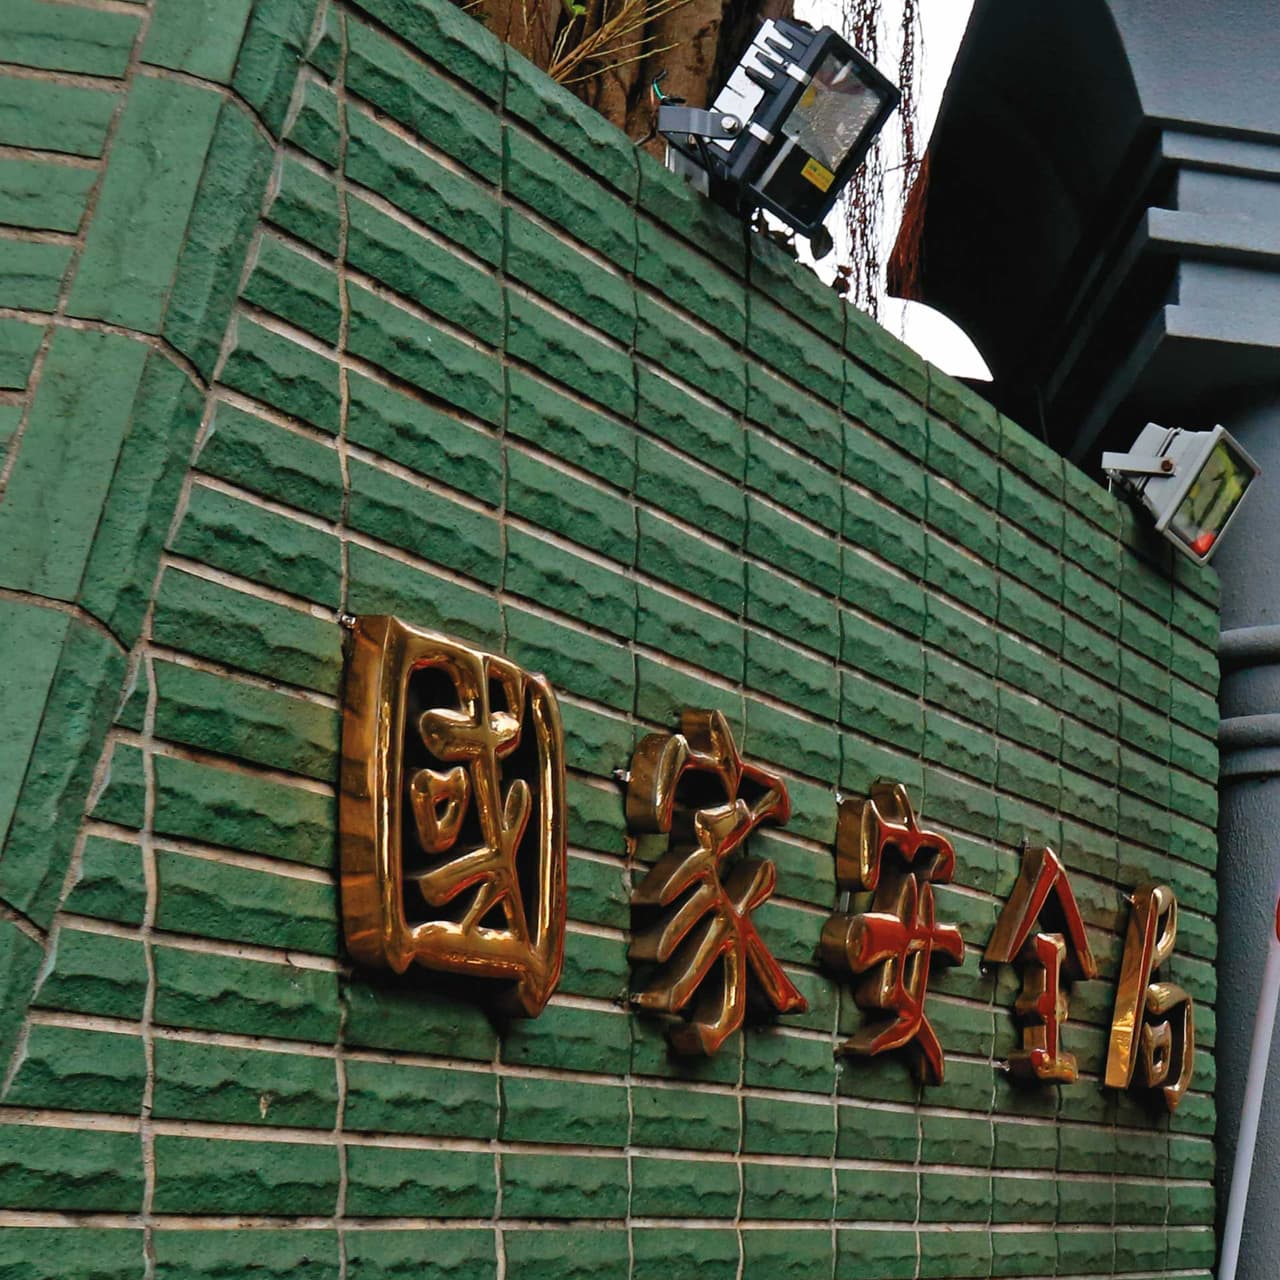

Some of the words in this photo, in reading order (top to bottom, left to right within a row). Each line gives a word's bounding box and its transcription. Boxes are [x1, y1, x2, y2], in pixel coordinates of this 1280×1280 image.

[340, 614, 1194, 1114] 國家安全局
